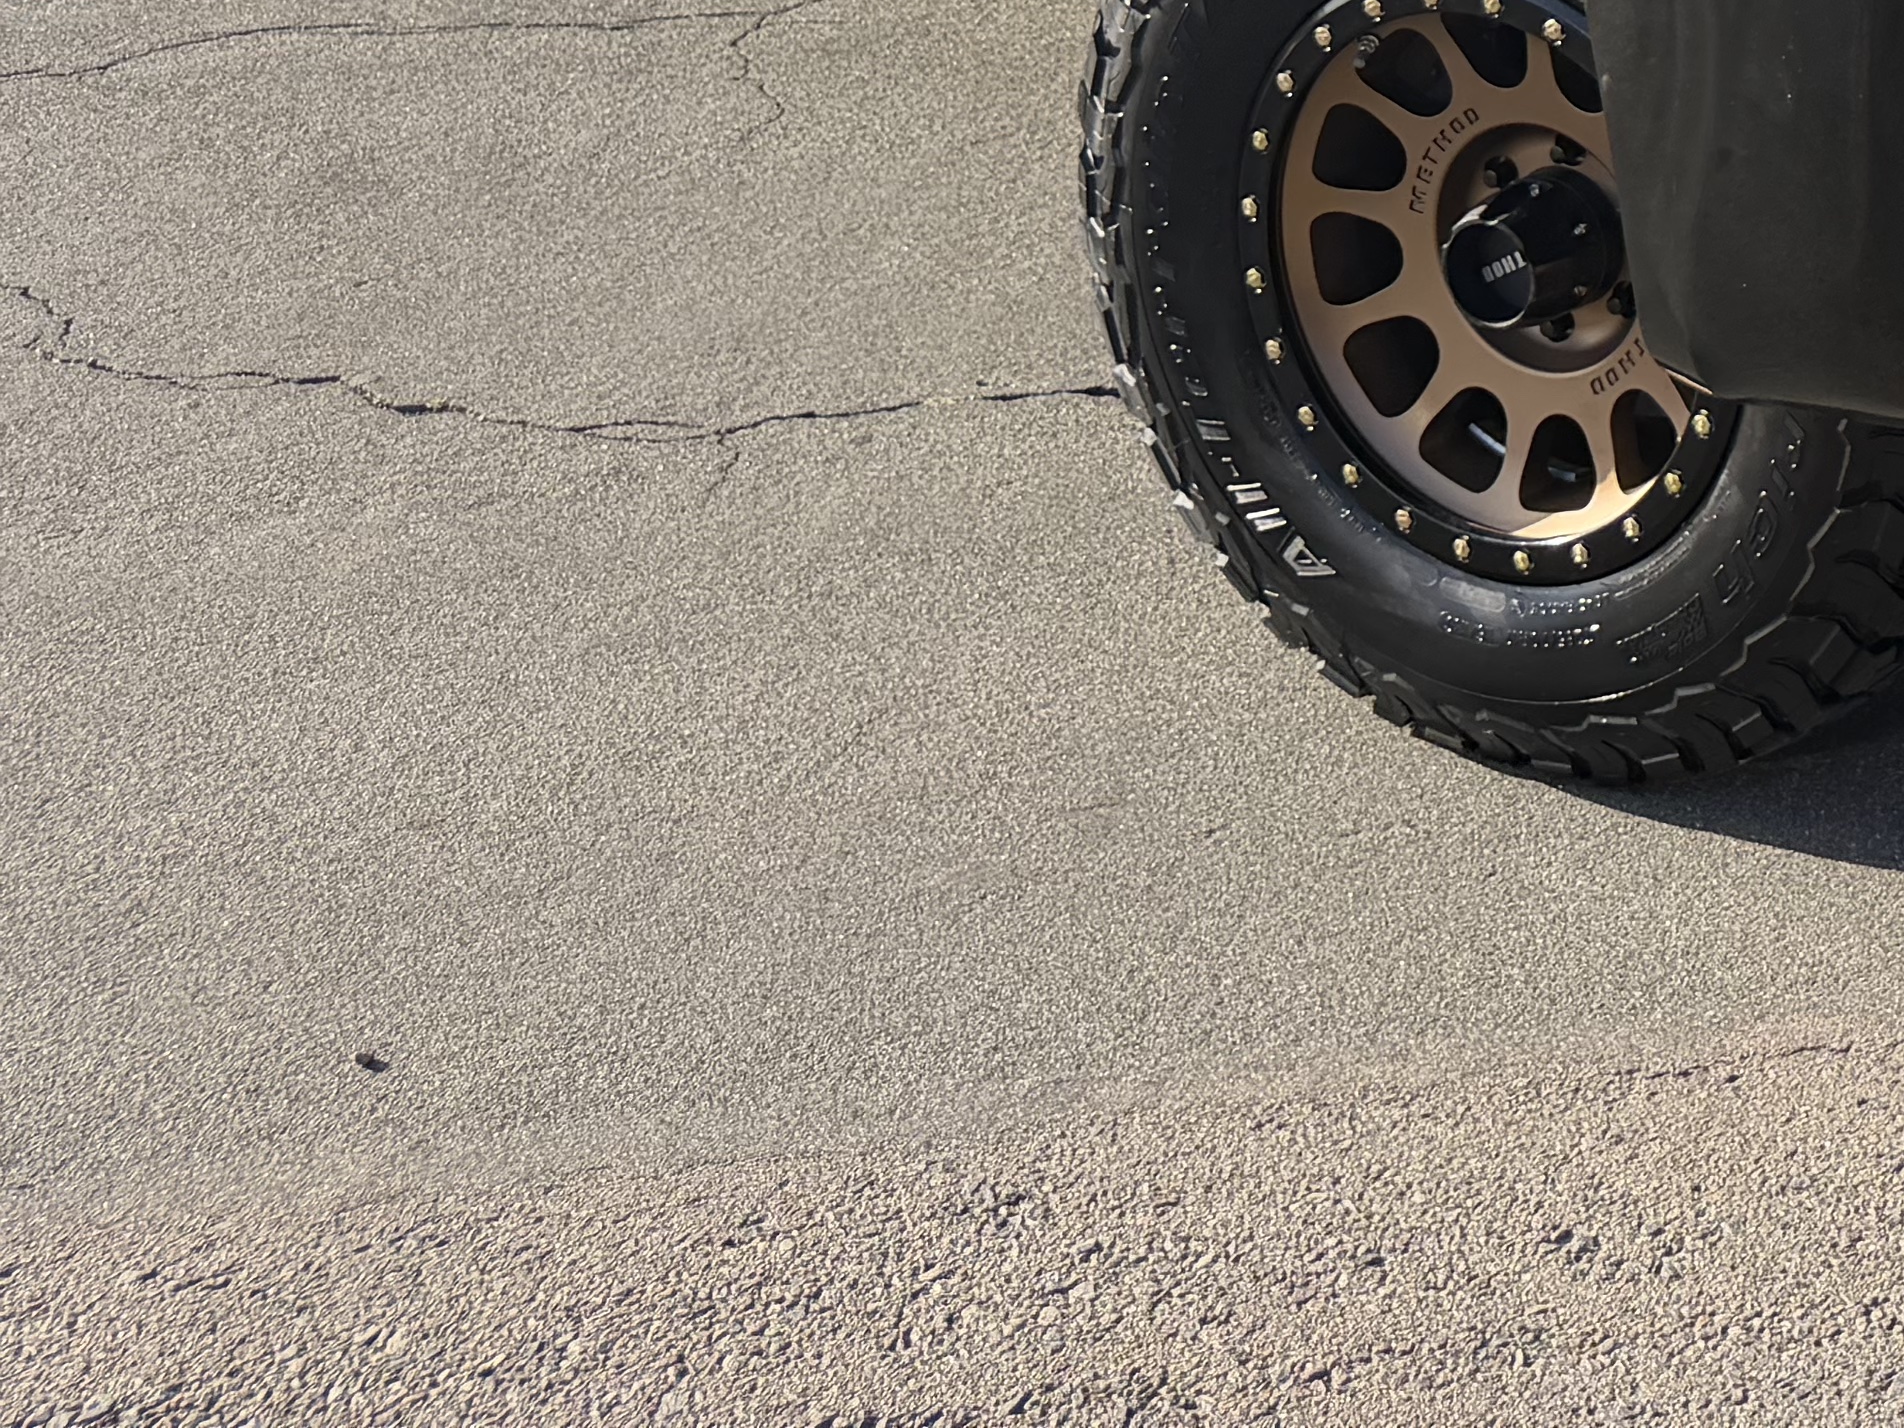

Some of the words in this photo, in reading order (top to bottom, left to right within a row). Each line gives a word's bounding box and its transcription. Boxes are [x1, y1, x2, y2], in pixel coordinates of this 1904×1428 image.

[1408, 107, 1480, 215] METHOD
[1481, 250, 1528, 284] THOD
[1589, 336, 1646, 396] THOD
